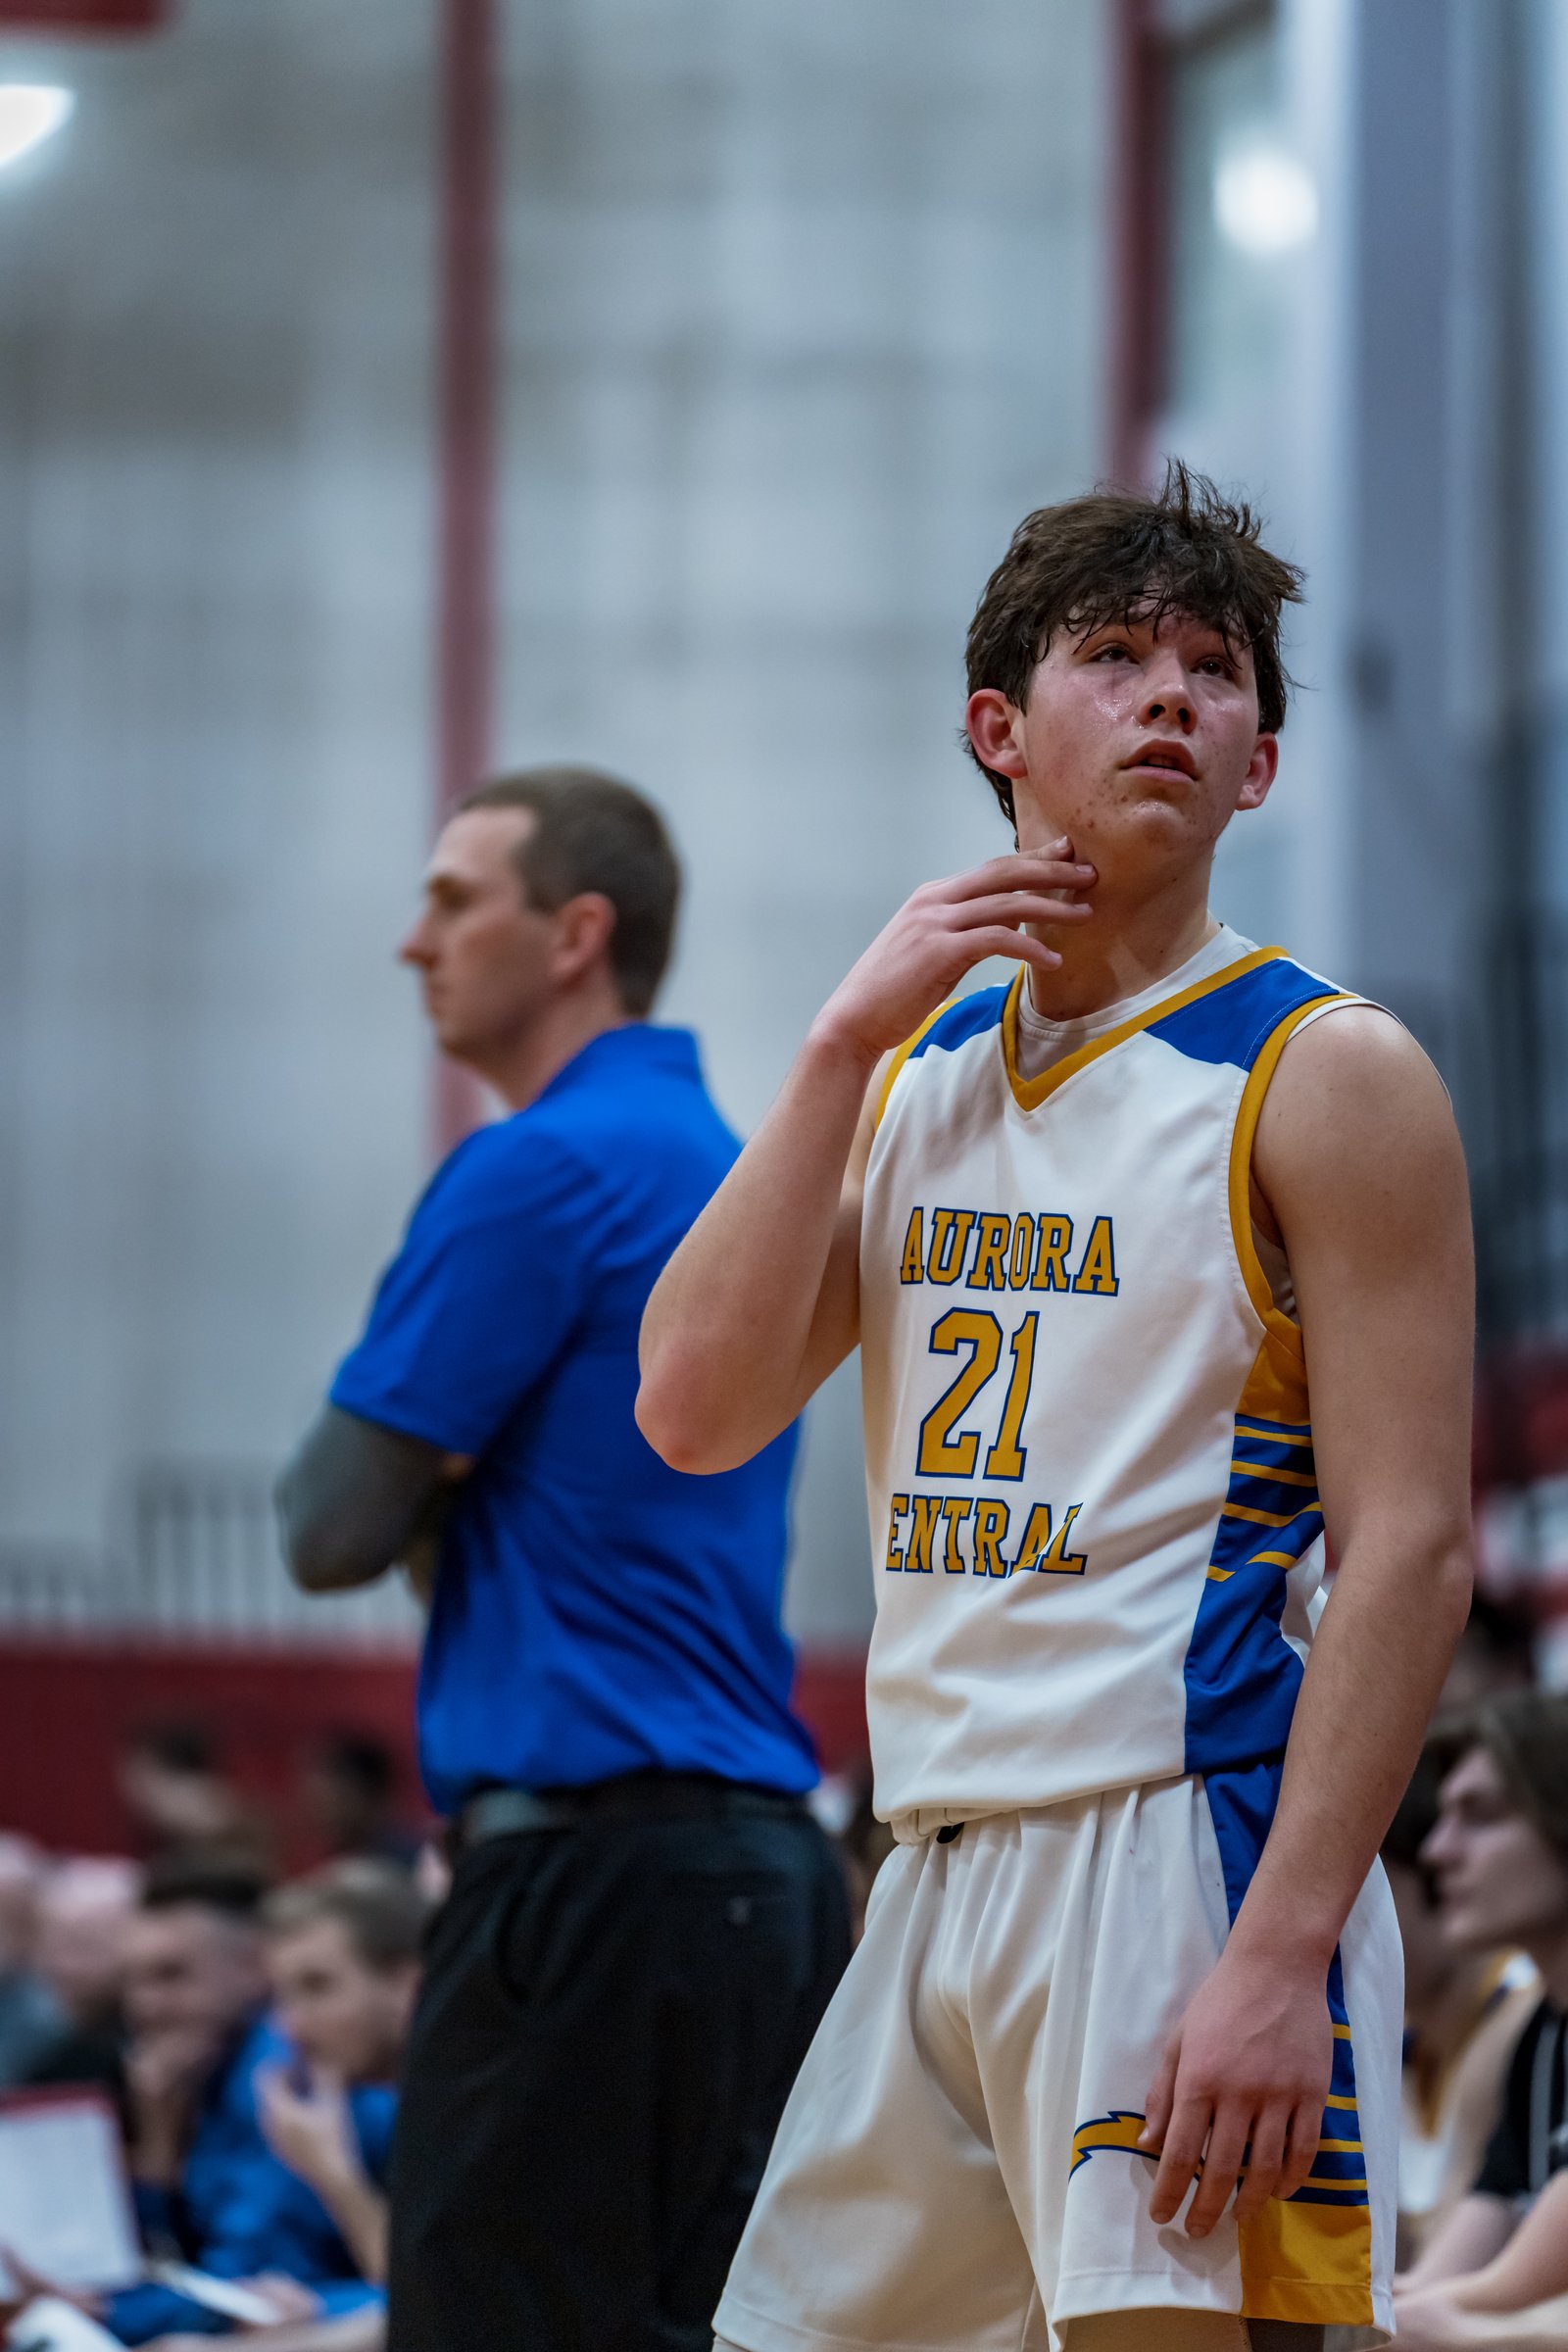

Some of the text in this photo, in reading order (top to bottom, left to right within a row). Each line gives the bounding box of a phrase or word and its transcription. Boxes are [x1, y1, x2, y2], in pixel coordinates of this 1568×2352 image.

[900, 1206, 1119, 1297] AURORA
[915, 1307, 1040, 1482] 21
[885, 1493, 1088, 1579] ENTRAL
